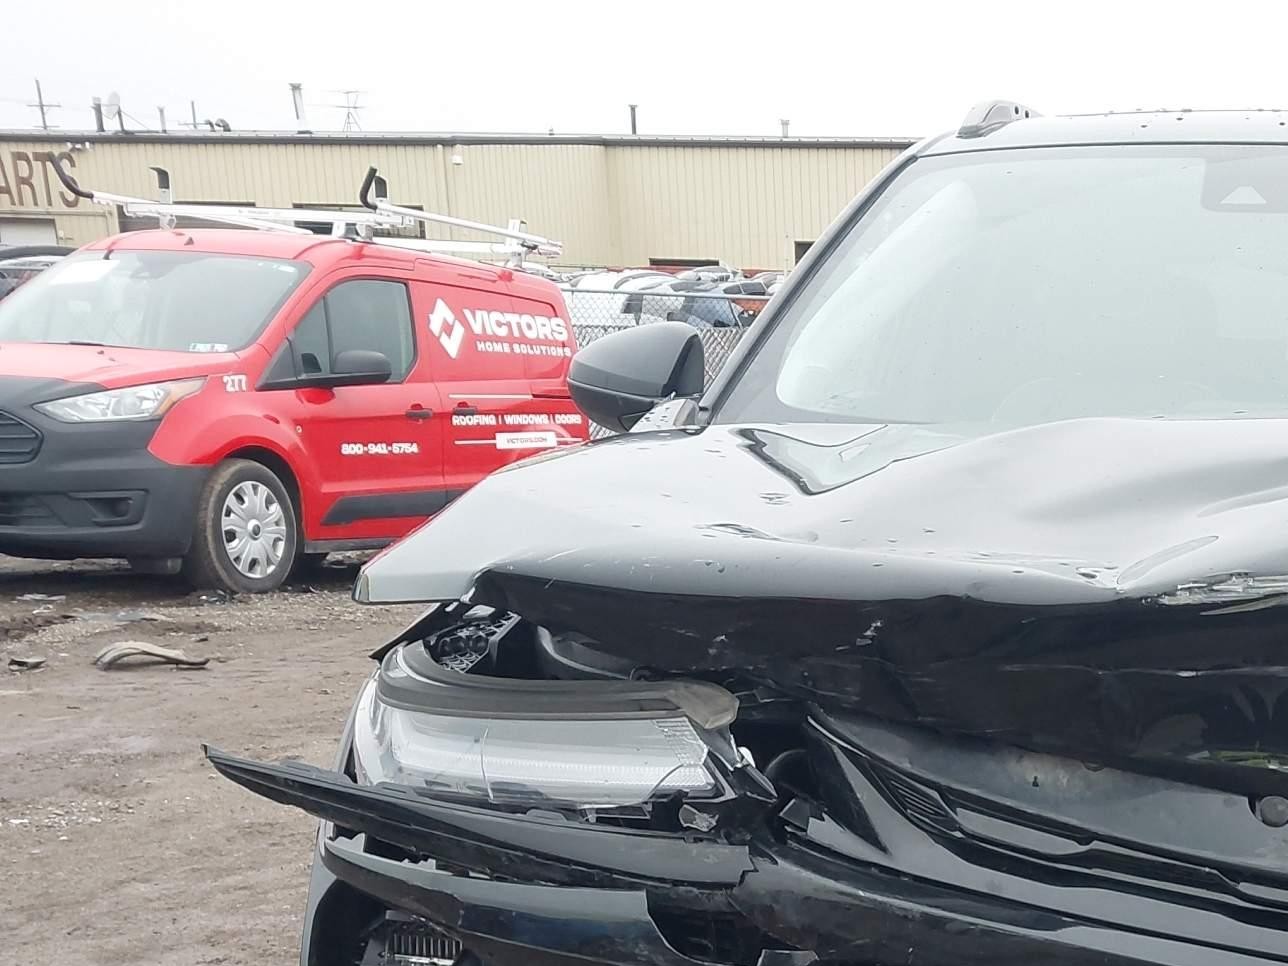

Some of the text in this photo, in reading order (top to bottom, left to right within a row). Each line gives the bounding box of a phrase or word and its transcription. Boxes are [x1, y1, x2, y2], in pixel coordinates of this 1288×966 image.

[462, 308, 568, 342] VICTORS
[476, 341, 572, 357] HOME SOLUTIONS
[223, 374, 247, 392] 277
[452, 414, 496, 425] ROOFING
[503, 414, 549, 425] WINDOWS
[555, 413, 582, 425] DOORS
[341, 442, 418, 455] 800-941-5754
